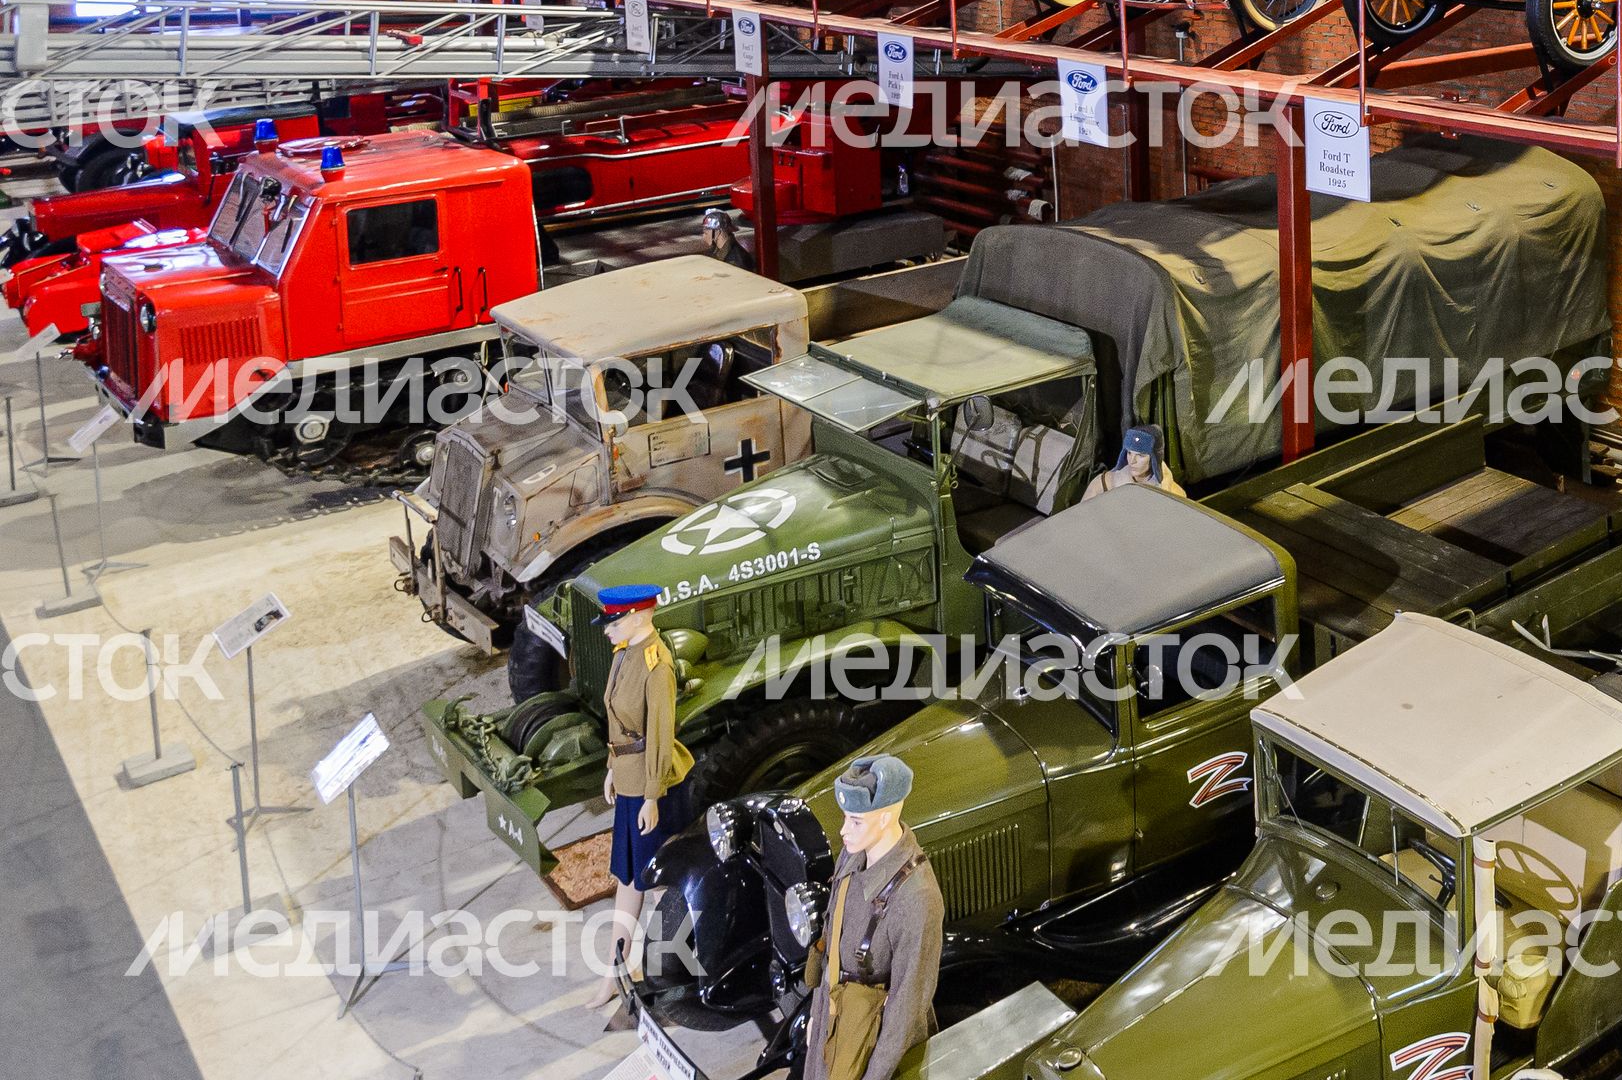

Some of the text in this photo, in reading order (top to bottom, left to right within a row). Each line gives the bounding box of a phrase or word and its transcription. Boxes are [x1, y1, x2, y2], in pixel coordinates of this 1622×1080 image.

[887, 44, 904, 59] Ford
[1071, 73, 1094, 91] Ford
[1321, 113, 1351, 135] Ford
[1323, 149, 1351, 163] Ford T
[1319, 161, 1355, 177] Roadster
[1328, 177, 1347, 188] 1925
[656, 541, 821, 607] U.S.A. 4S3001-S
